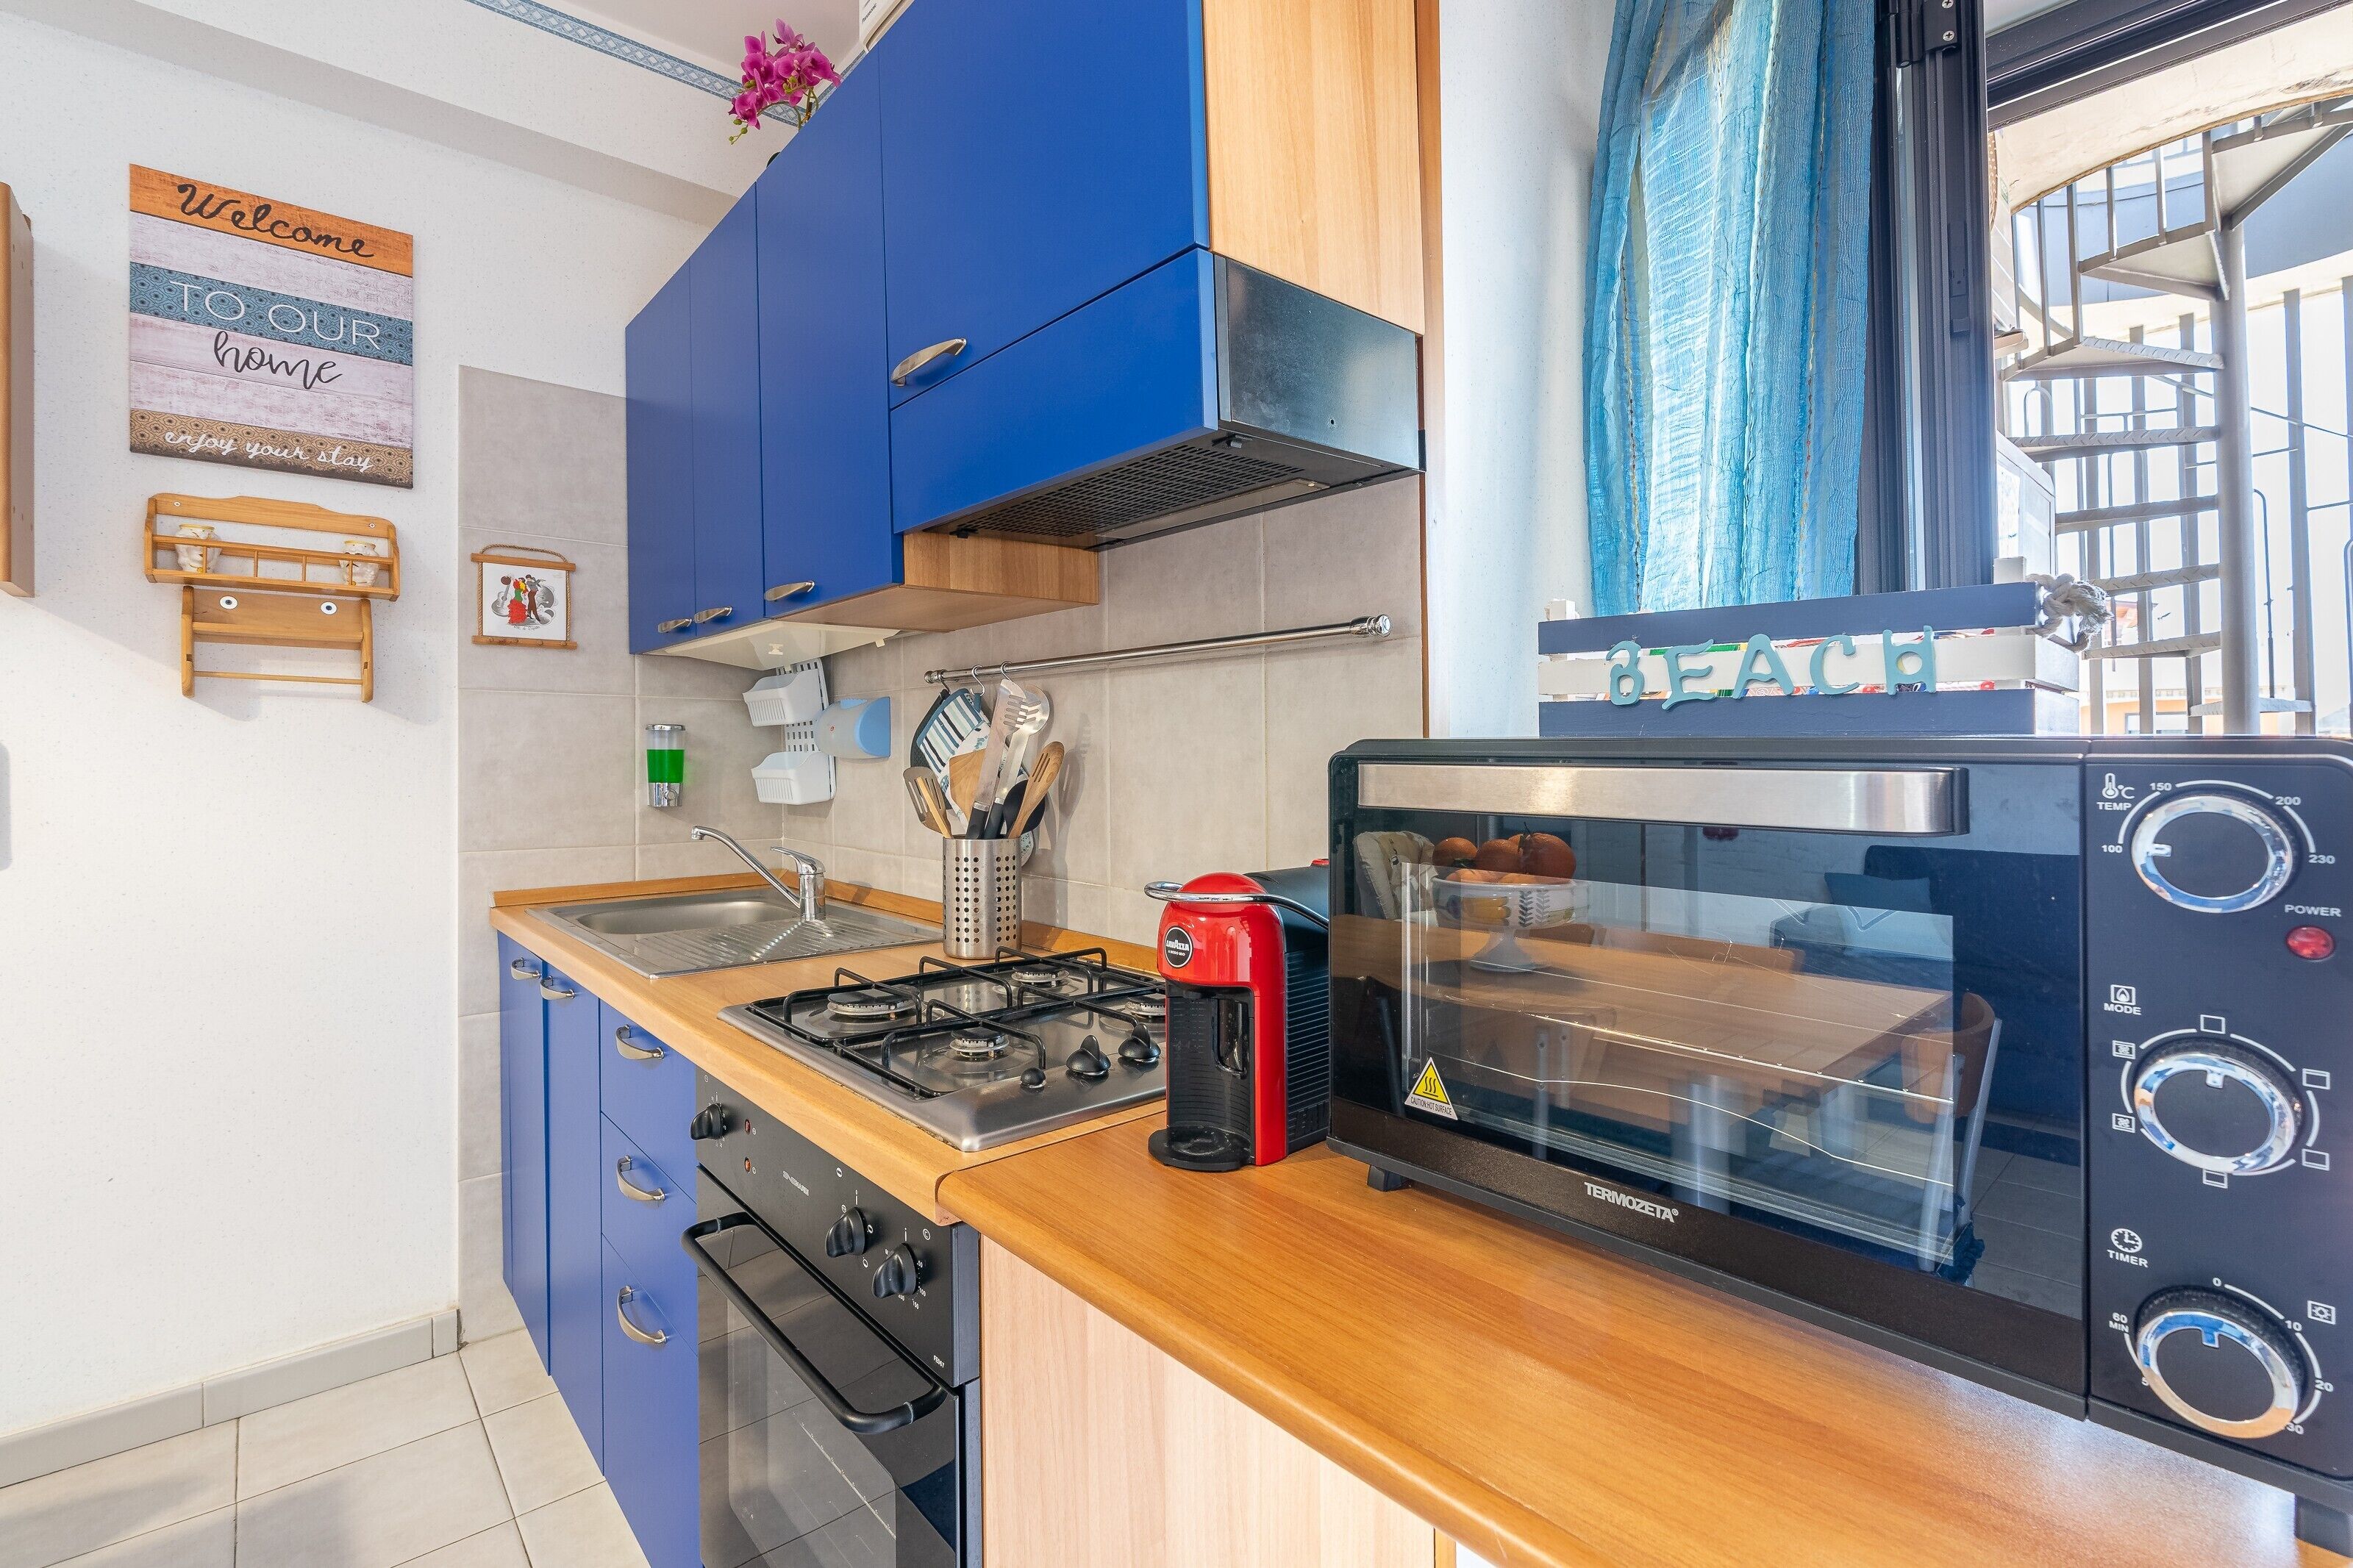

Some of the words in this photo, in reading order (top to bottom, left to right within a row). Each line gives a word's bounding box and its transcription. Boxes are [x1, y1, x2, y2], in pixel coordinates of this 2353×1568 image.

[177, 183, 374, 258] Welcome
[170, 280, 246, 321] TO
[268, 304, 381, 350] OUR
[214, 331, 343, 390] home
[165, 431, 238, 455] enjoy
[246, 443, 310, 459] your
[317, 445, 373, 472] stay
[1606, 625, 1936, 710] BEACH
[2149, 782, 2172, 791] 150
[2096, 801, 2132, 810] TEMP
[2275, 796, 2302, 806] 200
[2102, 845, 2123, 853] 100
[2308, 854, 2335, 864] 230
[2285, 904, 2342, 917] POWER
[2104, 1003, 2141, 1015] MODE
[1435, 1103, 1452, 1116] SURFACE
[2107, 1250, 2149, 1268] TIMER
[2213, 1277, 2222, 1286] 0
[2113, 1312, 2128, 1323] 60
[2109, 1320, 2129, 1333] MIN
[2285, 1320, 2302, 1331] 10
[2141, 1377, 2149, 1386] 5
[2315, 1379, 2334, 1392] 20
[2286, 1422, 2304, 1434] 30
